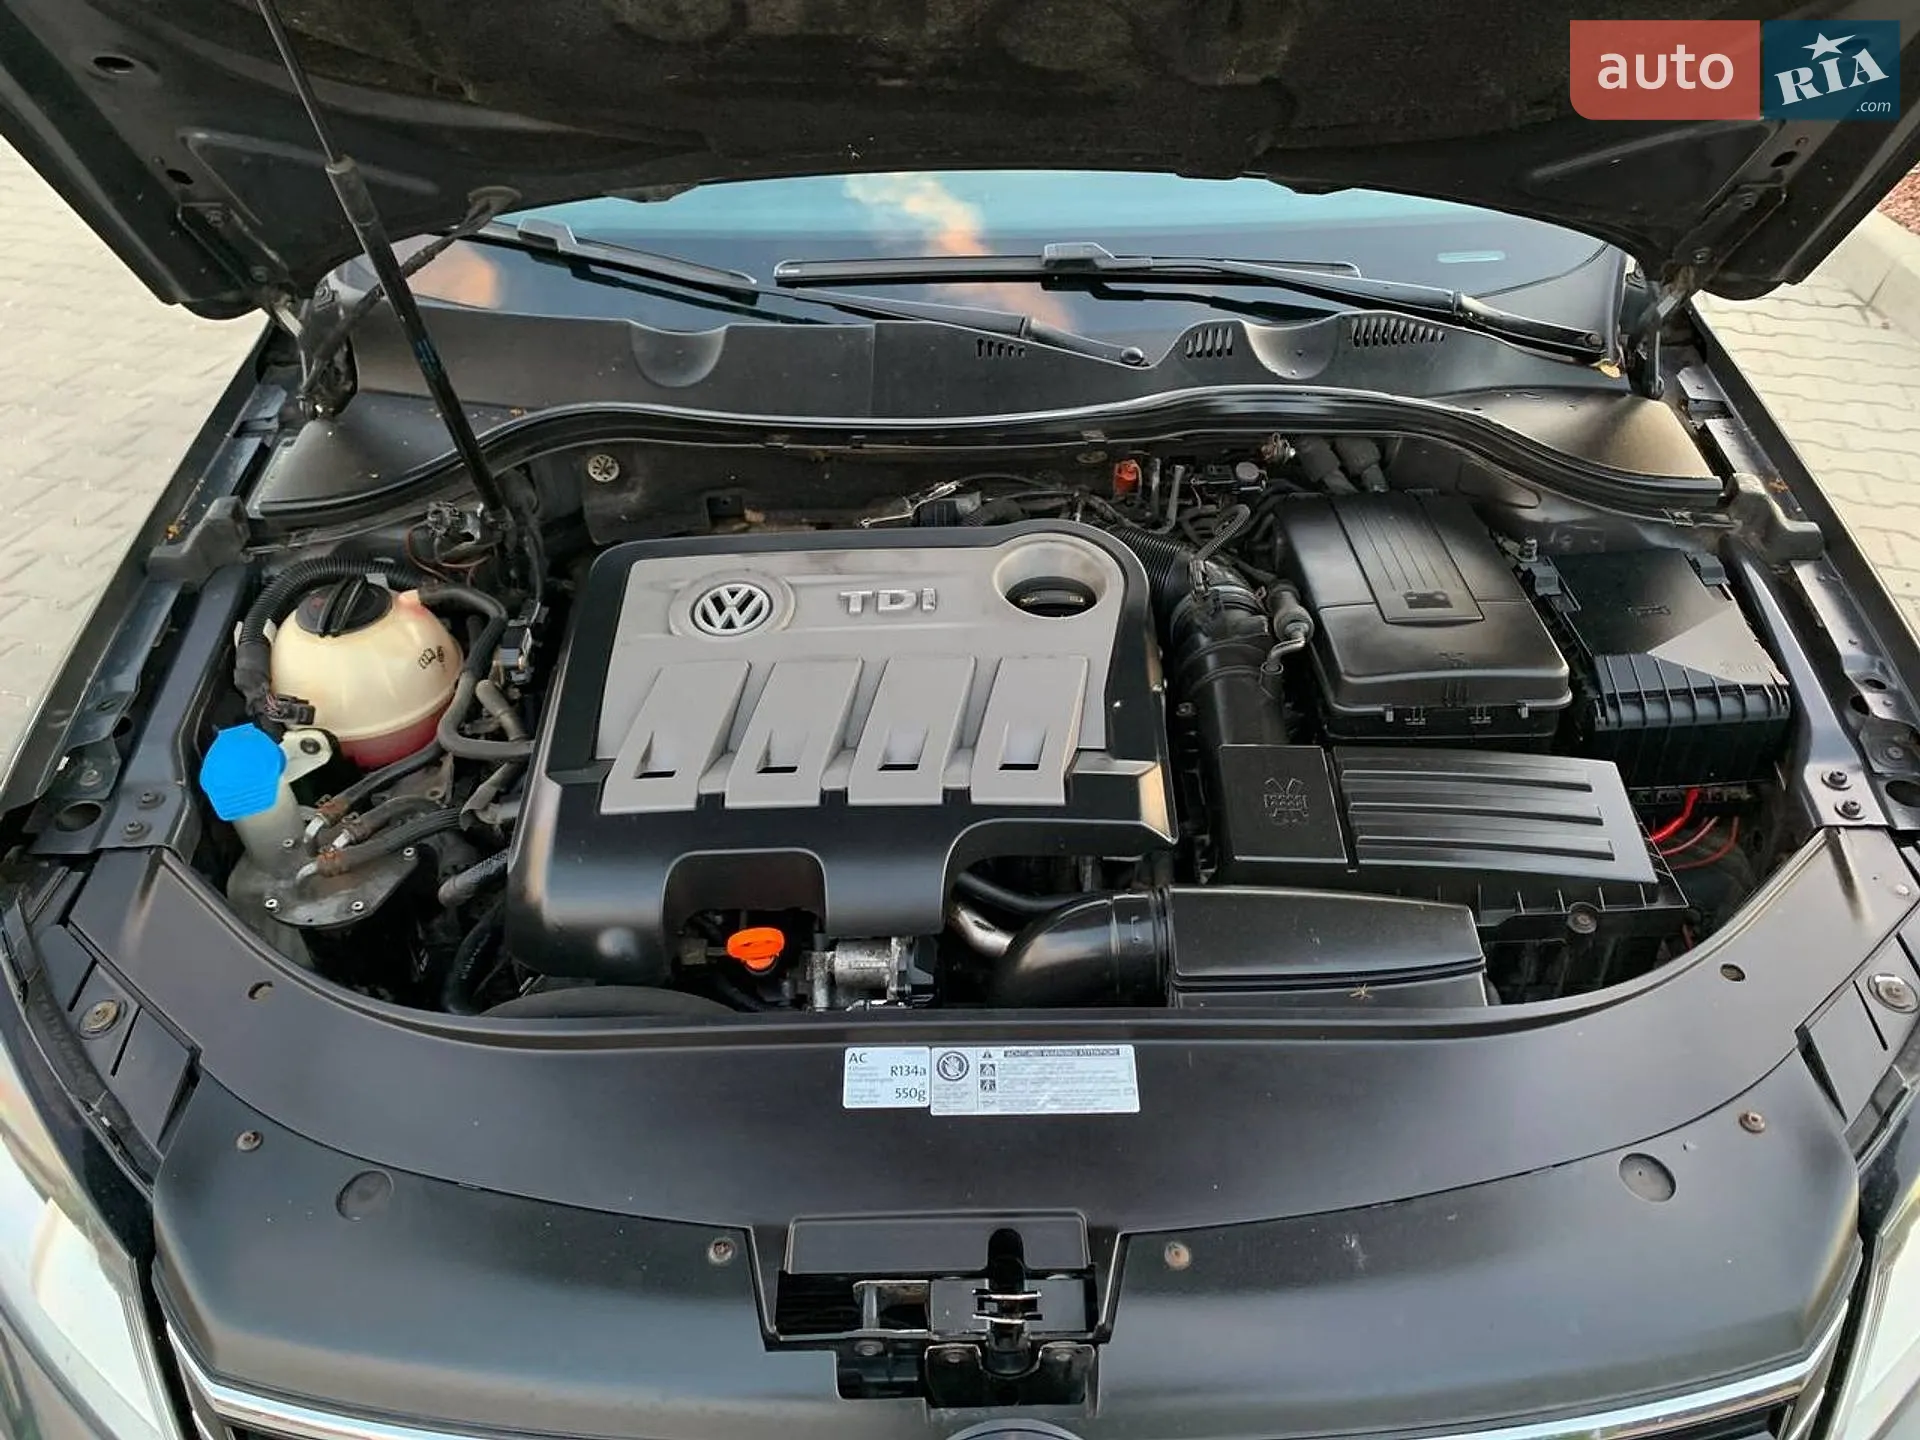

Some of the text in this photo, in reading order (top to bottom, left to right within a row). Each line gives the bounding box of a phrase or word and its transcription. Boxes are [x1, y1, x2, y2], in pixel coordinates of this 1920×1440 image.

[849, 1052, 868, 1064] AC
[890, 1064, 927, 1077] R134a
[895, 1087, 926, 1102] 550g
